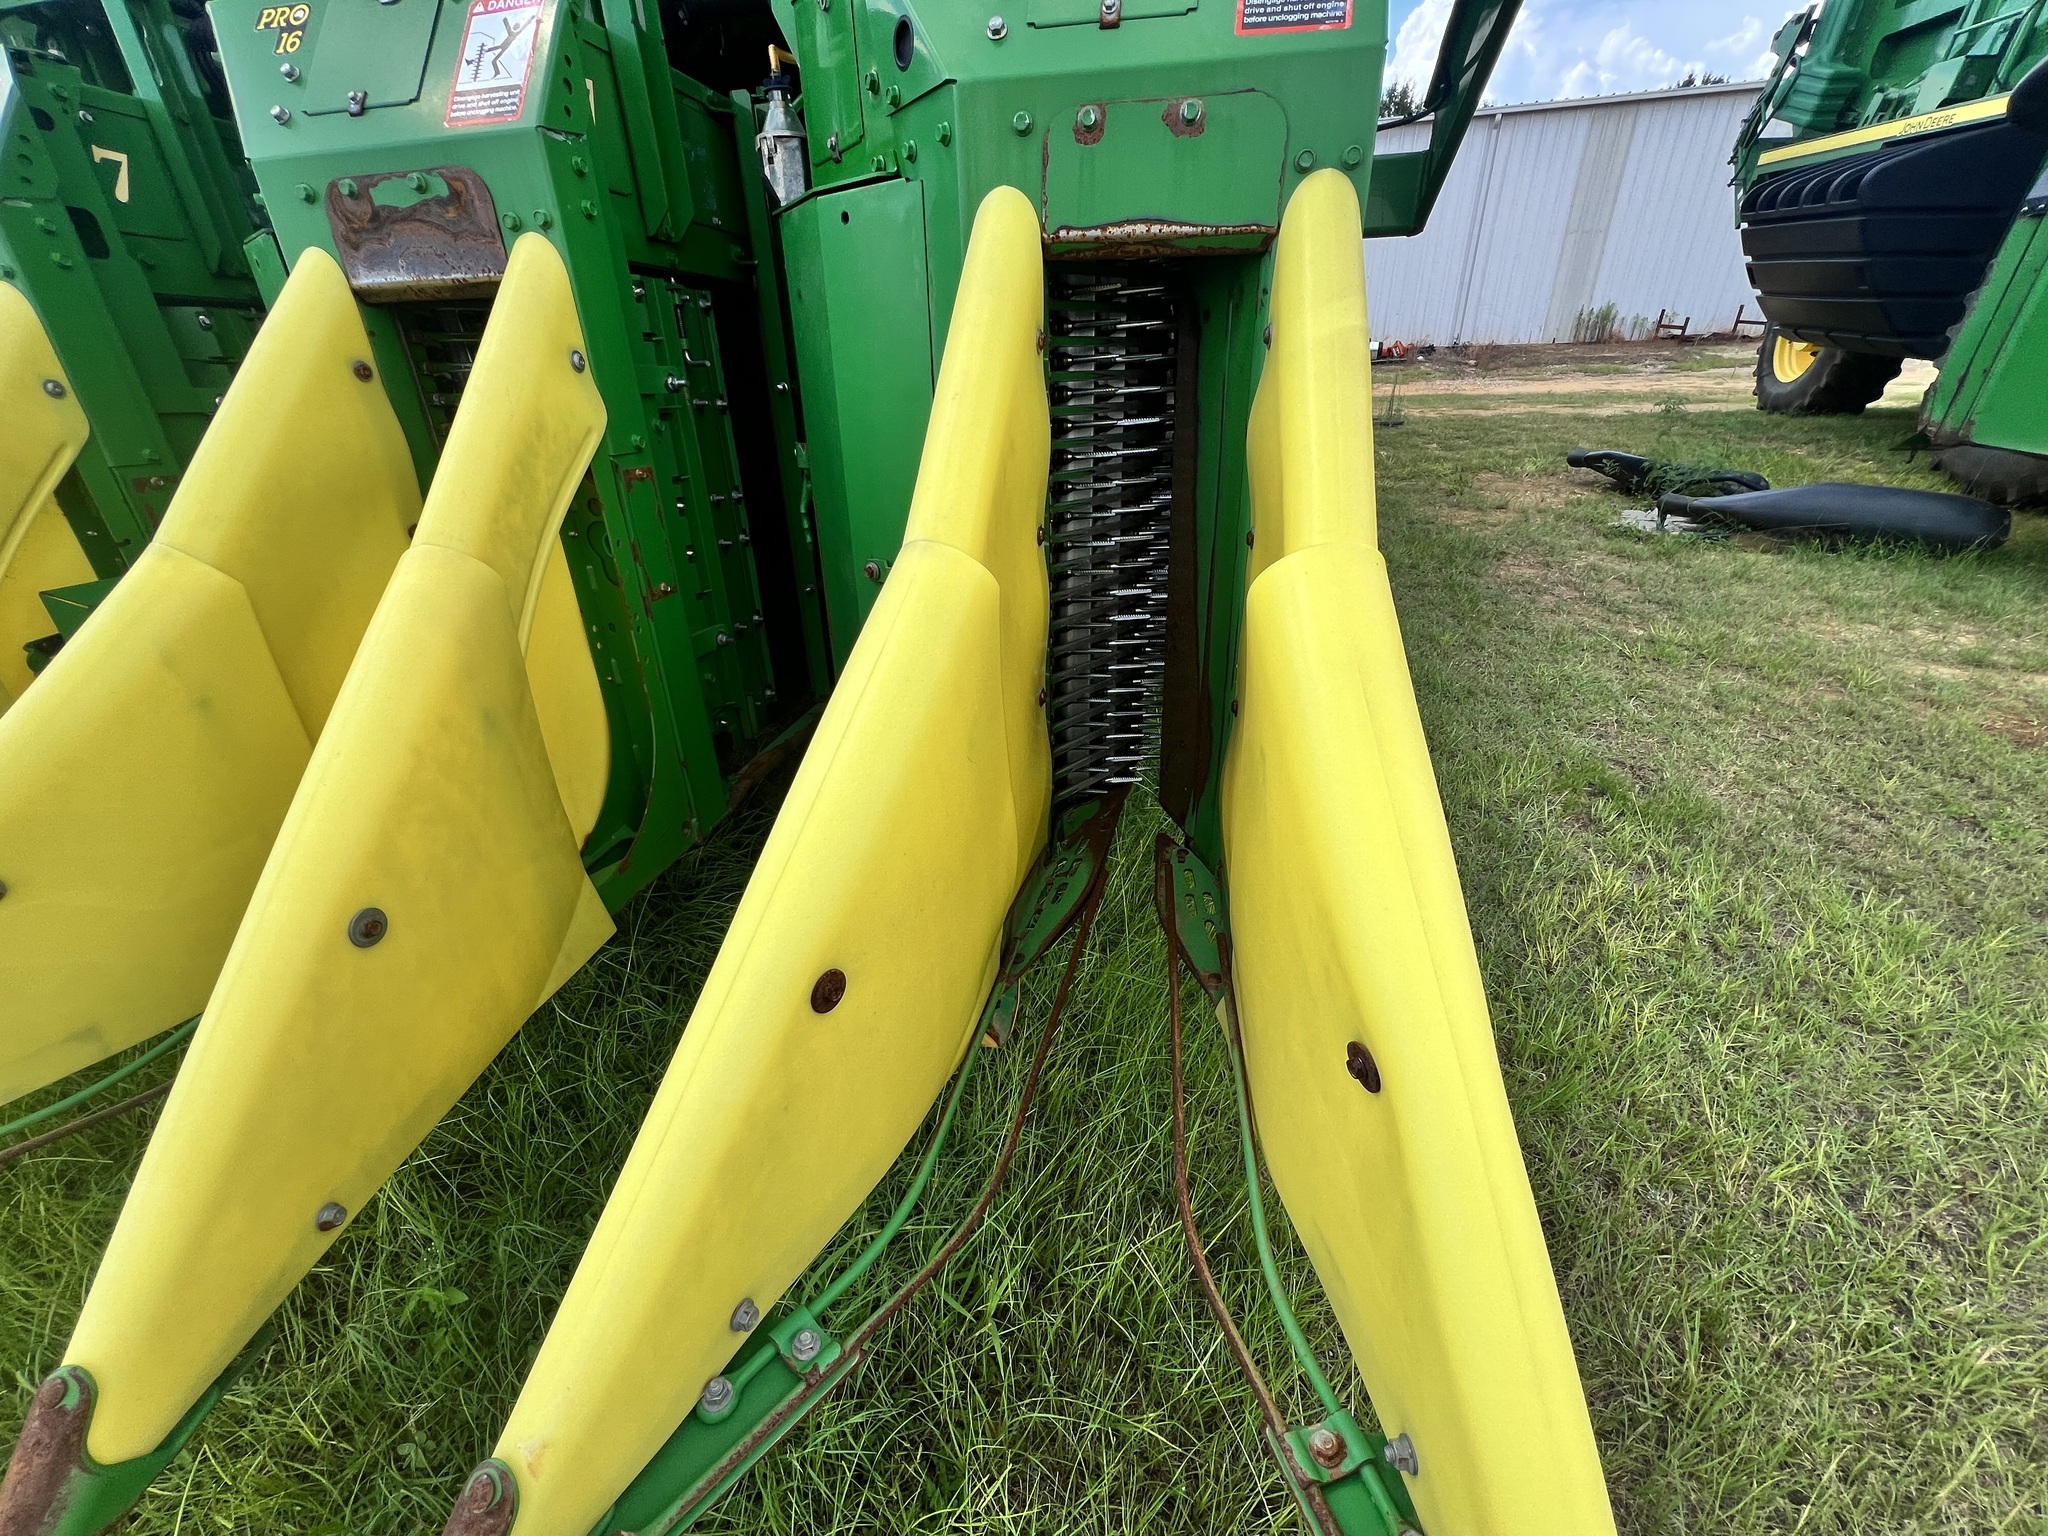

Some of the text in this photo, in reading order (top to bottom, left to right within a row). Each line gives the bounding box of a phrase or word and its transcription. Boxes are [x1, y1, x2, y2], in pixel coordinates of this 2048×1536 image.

[487, 0, 540, 10] DANGE
[1266, 5, 1281, 13] and
[1283, 4, 1302, 12] shut
[1316, 1, 1345, 10] engine
[256, 4, 310, 30] PRO
[1243, 10, 1344, 23] before unclogging machine.
[275, 30, 303, 54] 16
[1898, 113, 1957, 135] JOHN DEERE
[91, 144, 129, 203] 7
